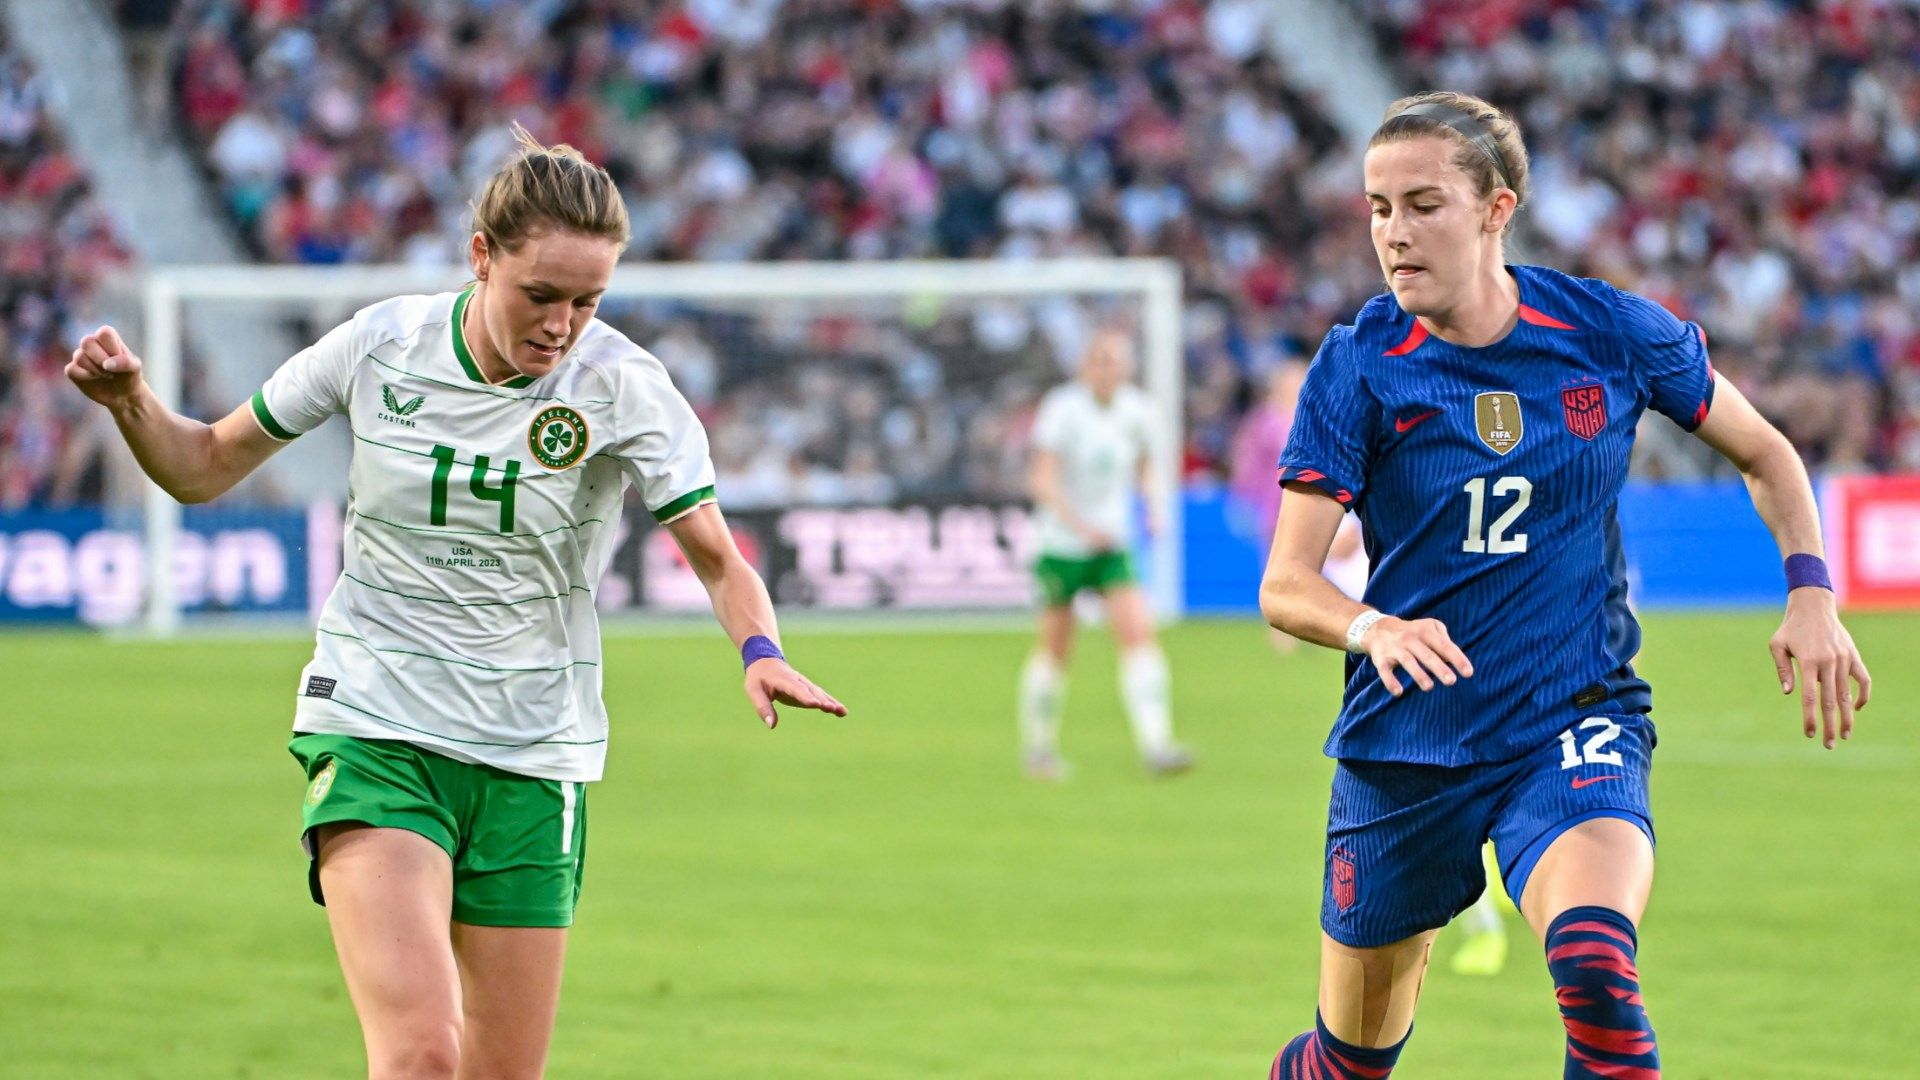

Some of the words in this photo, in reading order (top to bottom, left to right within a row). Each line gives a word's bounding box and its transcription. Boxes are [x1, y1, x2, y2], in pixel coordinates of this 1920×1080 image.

[1564, 388, 1600, 411] USA
[378, 412, 416, 428] CASTORE
[535, 410, 584, 432] IRELAND
[1490, 430, 1511, 439] FIFA
[430, 444, 522, 533] 14
[1462, 476, 1533, 554] 12
[425, 556, 444, 566] 11th
[445, 558, 476, 567] APRIL
[478, 559, 501, 567] 2023
[451, 547, 473, 556] USA
[0, 529, 288, 626] agen
[1558, 717, 1624, 770] 12
